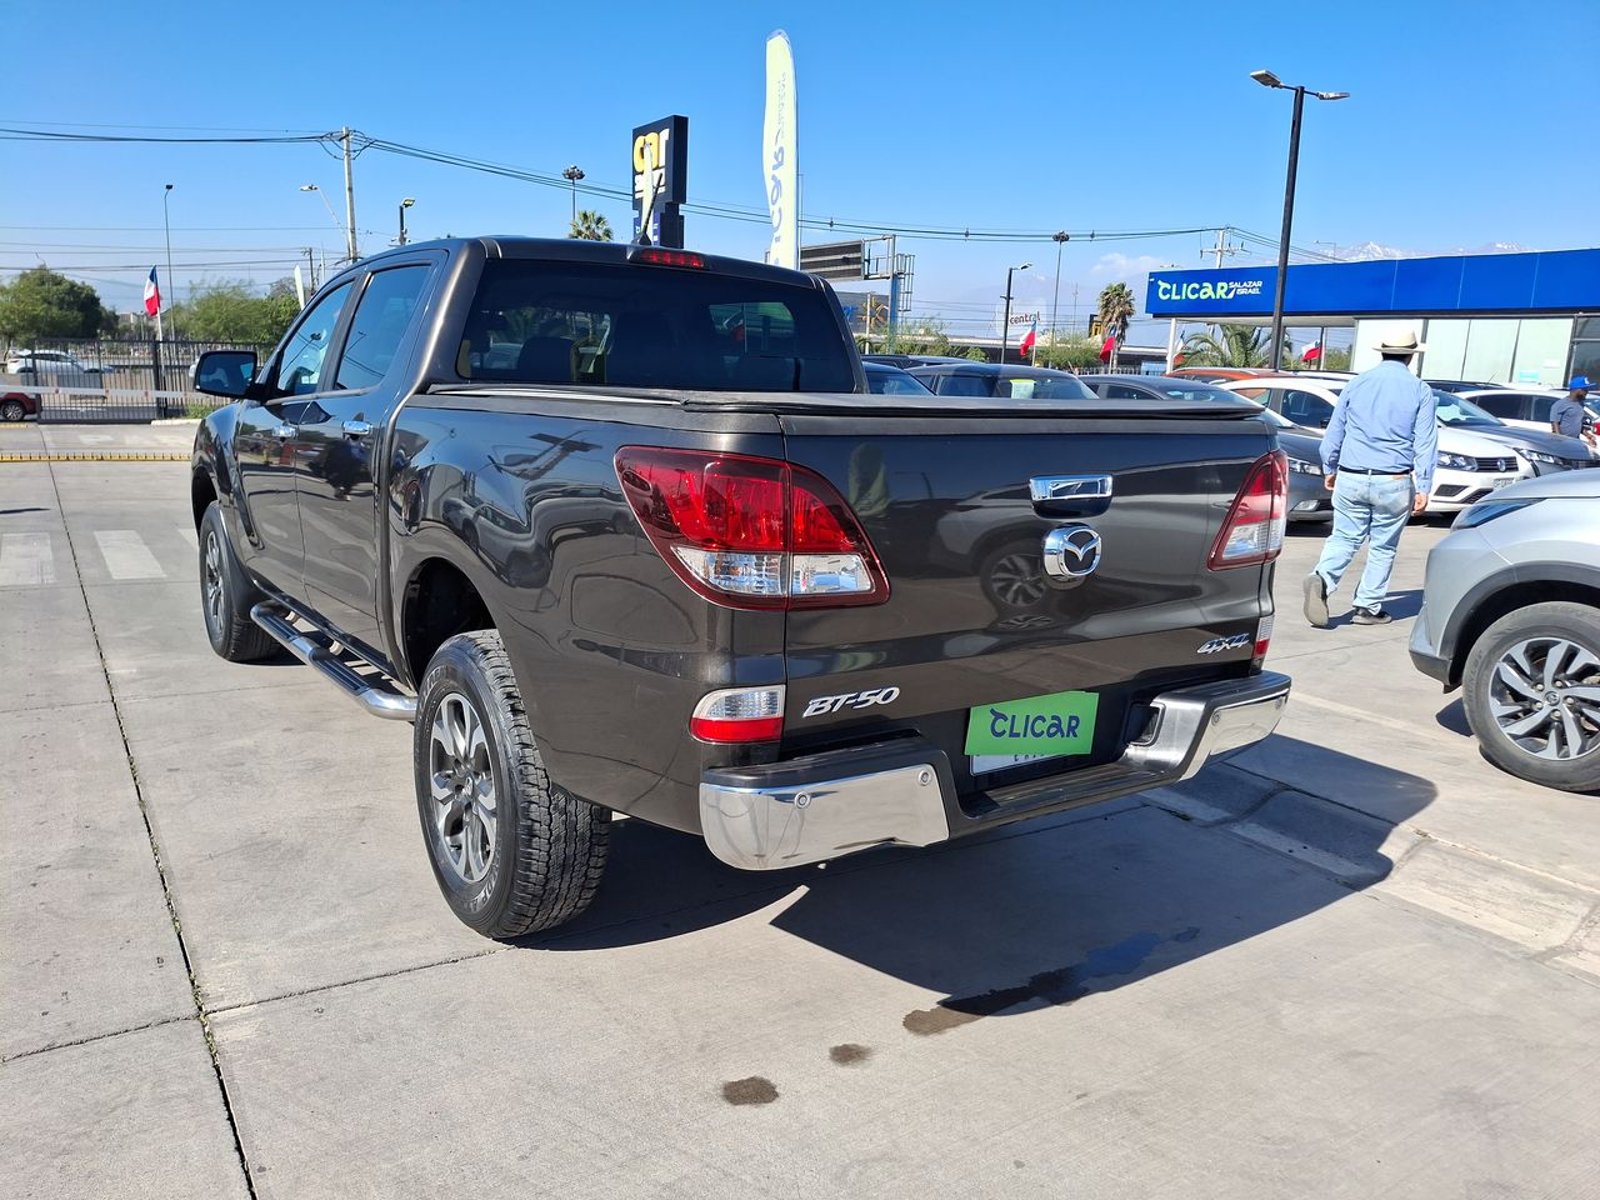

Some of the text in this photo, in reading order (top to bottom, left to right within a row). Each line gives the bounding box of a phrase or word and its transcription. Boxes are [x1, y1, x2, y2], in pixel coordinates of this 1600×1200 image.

[1228, 280, 1263, 288] SALAZAR
[1236, 287, 1262, 295] ISRAEL
[1010, 311, 1041, 325] central
[802, 686, 901, 718] BT-50
